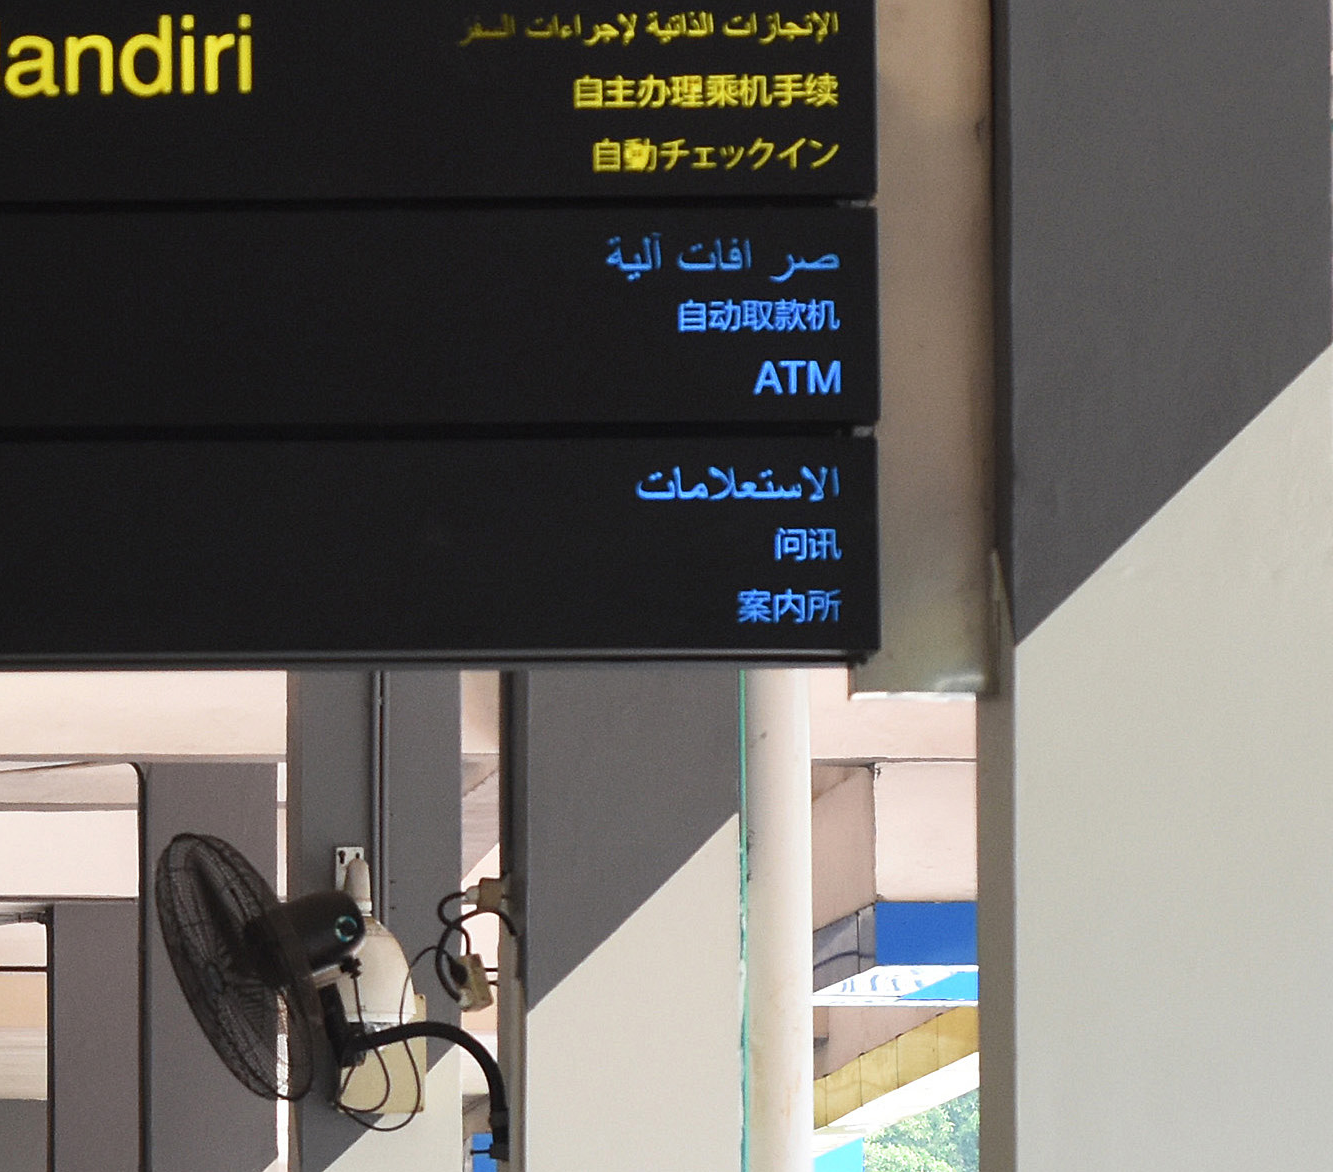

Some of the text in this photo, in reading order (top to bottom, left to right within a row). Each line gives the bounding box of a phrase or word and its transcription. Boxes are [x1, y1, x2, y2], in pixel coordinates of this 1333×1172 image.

[573, 73, 839, 109] 自主办理乘机手续
[592, 137, 839, 172] 自動チェックイン
[677, 298, 841, 333] 自动取款机
[753, 359, 842, 396] ATM
[635, 465, 840, 503] الاستعلامات
[774, 527, 842, 562] 问讯
[737, 588, 841, 624] 案内所
